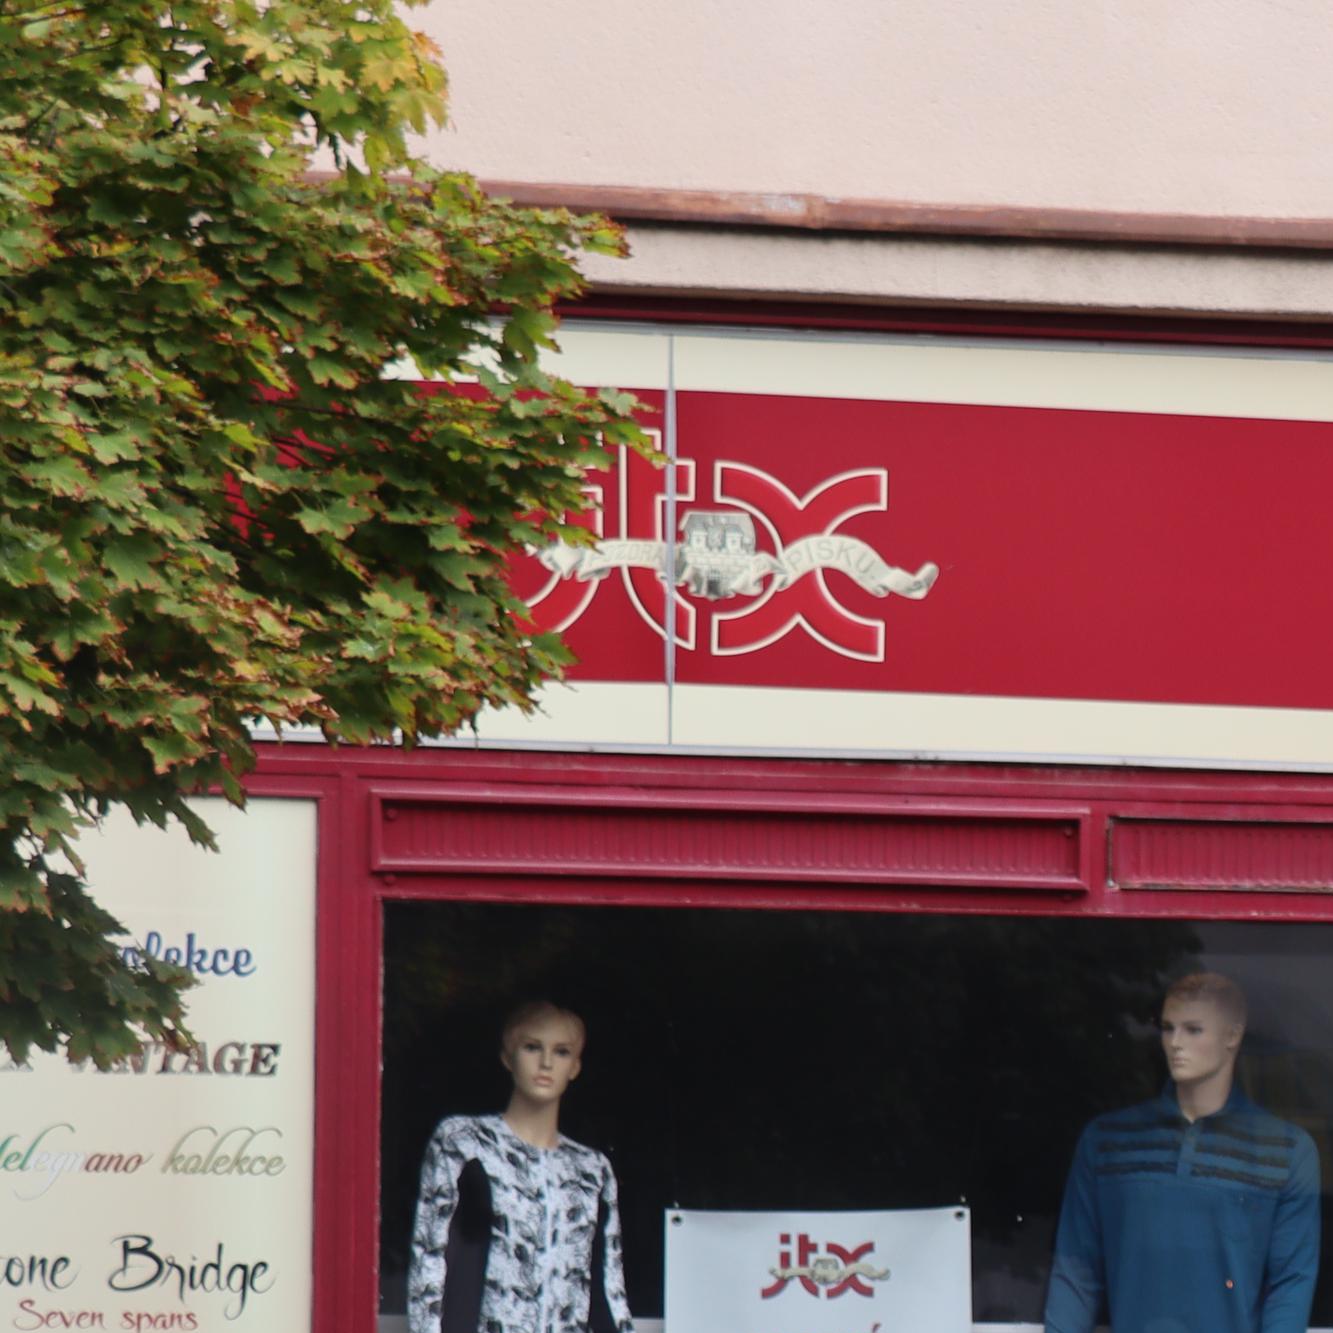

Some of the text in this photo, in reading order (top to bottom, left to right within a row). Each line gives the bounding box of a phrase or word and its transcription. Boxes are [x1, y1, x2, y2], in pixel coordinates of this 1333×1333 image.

[118, 931, 257, 977] olekce
[0, 1123, 286, 1201] elegnano kolekce
[0, 1234, 276, 1321] one Bridge
[13, 1299, 106, 1331] Seven
